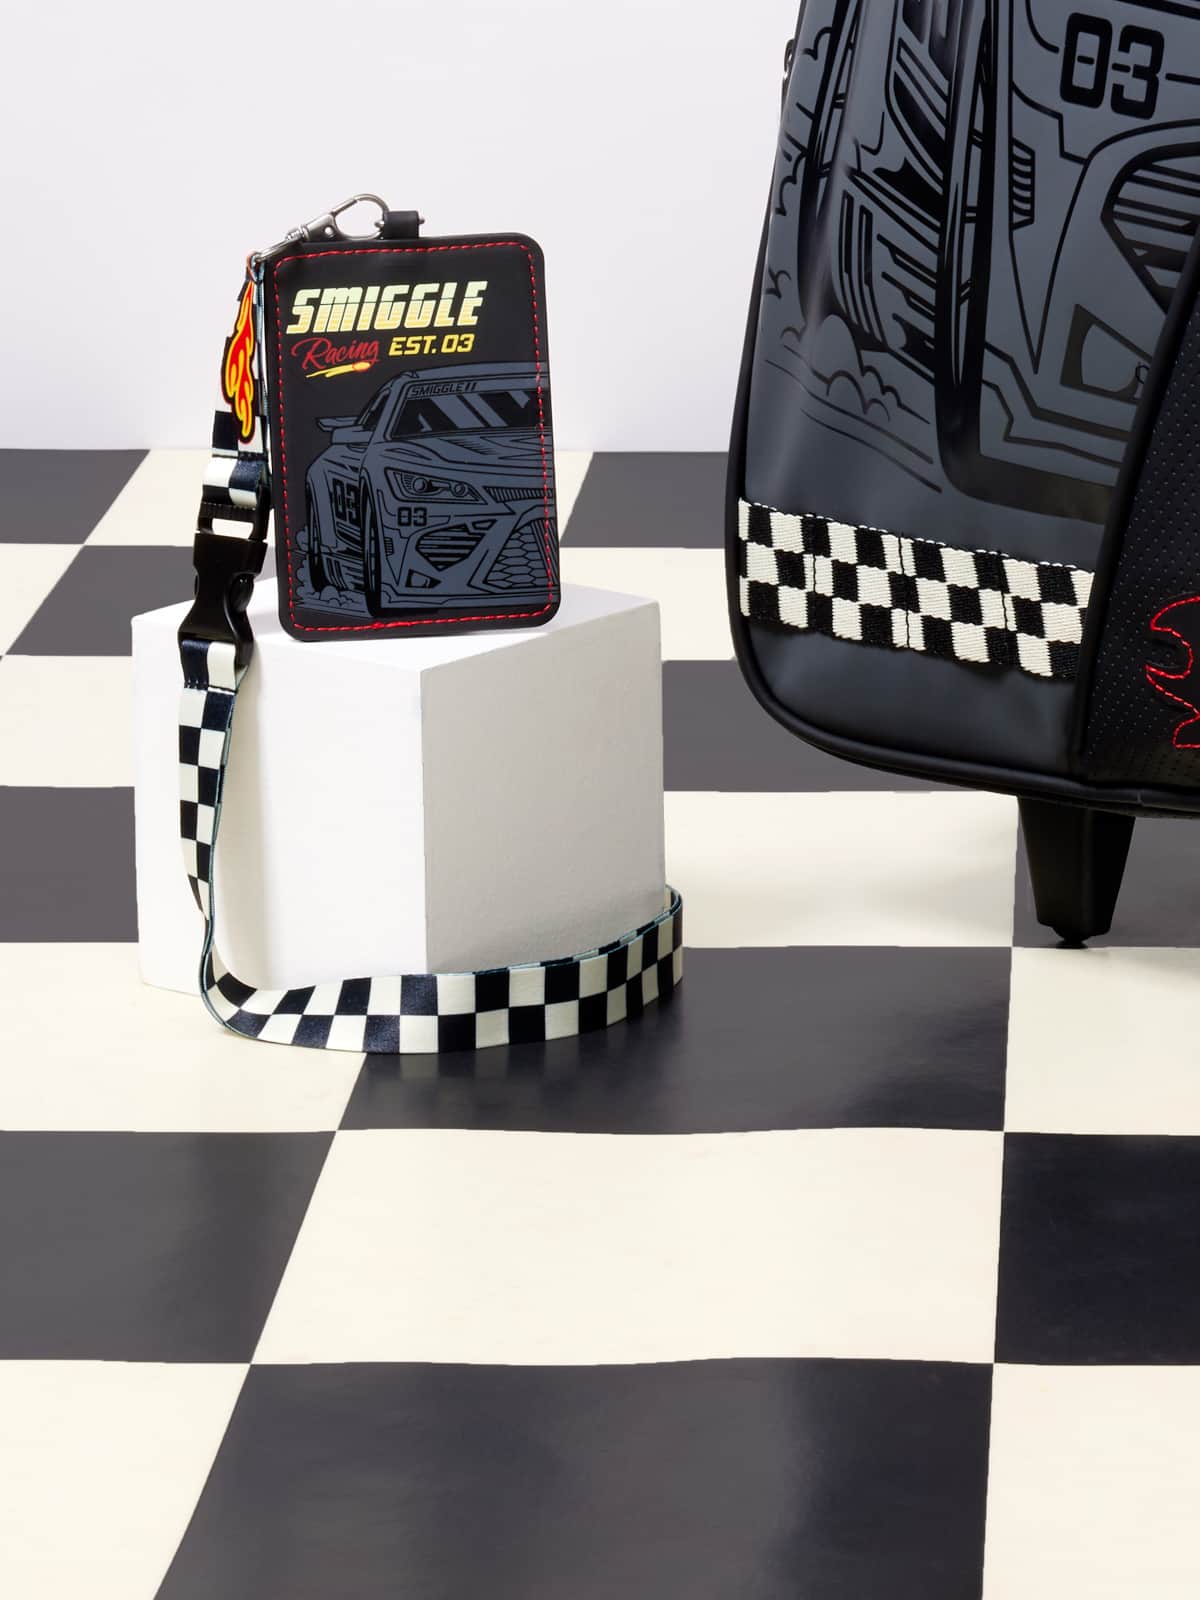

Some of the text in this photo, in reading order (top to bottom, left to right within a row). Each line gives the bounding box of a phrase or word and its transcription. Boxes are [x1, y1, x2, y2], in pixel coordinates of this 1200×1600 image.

[1059, 11, 1165, 120] 03
[286, 281, 488, 334] SMIGGLE
[291, 333, 475, 371] Racing EST. 03
[397, 506, 428, 527] 03
